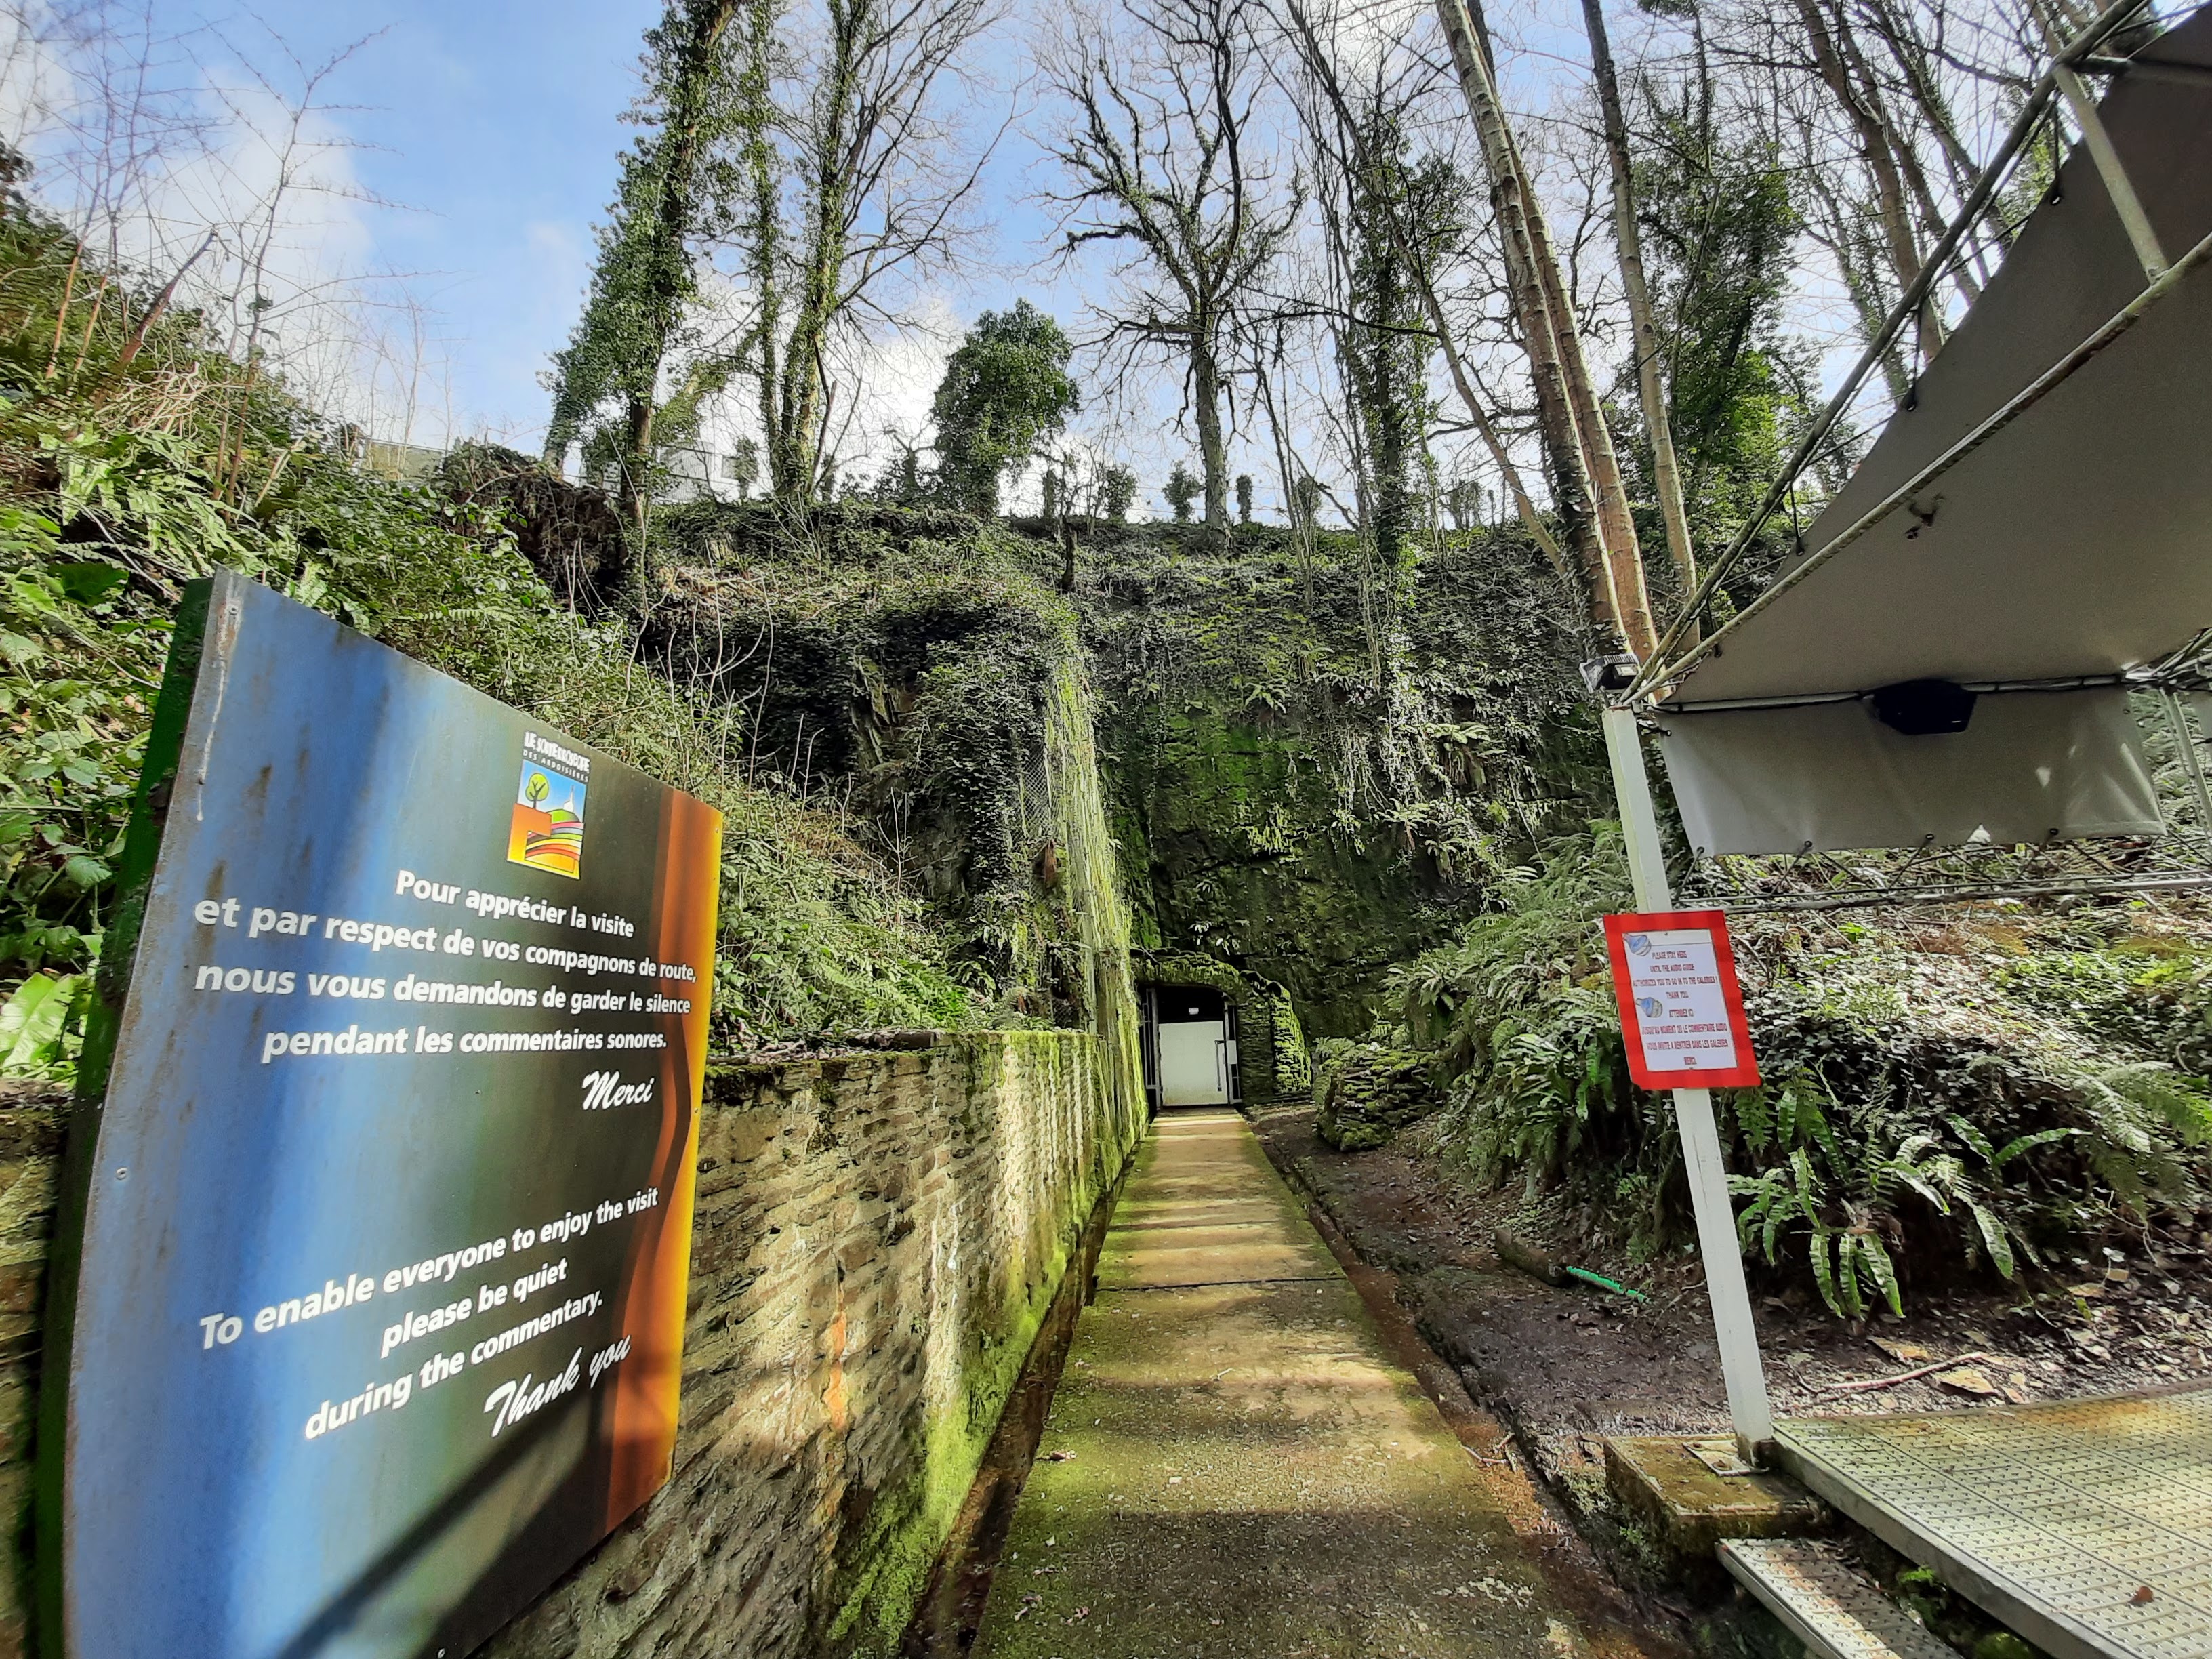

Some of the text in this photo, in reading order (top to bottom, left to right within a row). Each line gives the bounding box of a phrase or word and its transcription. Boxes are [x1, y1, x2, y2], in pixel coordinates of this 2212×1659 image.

[523, 750, 537, 760] DES
[525, 732, 537, 750] LE
[396, 870, 634, 937] Pour apprécier la visite
[194, 898, 695, 983] et par respect de vos compagnons de route,
[194, 966, 690, 1014] nous vous demandons de garder le silence
[262, 1025, 666, 1063] pendant les commentaires sonores.
[582, 1071, 654, 1109] Merci
[200, 1188, 657, 1349] To enable everyone to enjoy the visit
[381, 1258, 567, 1359] please be quiet
[305, 1289, 602, 1439] during the commentary.
[484, 1336, 630, 1437] Thank you
